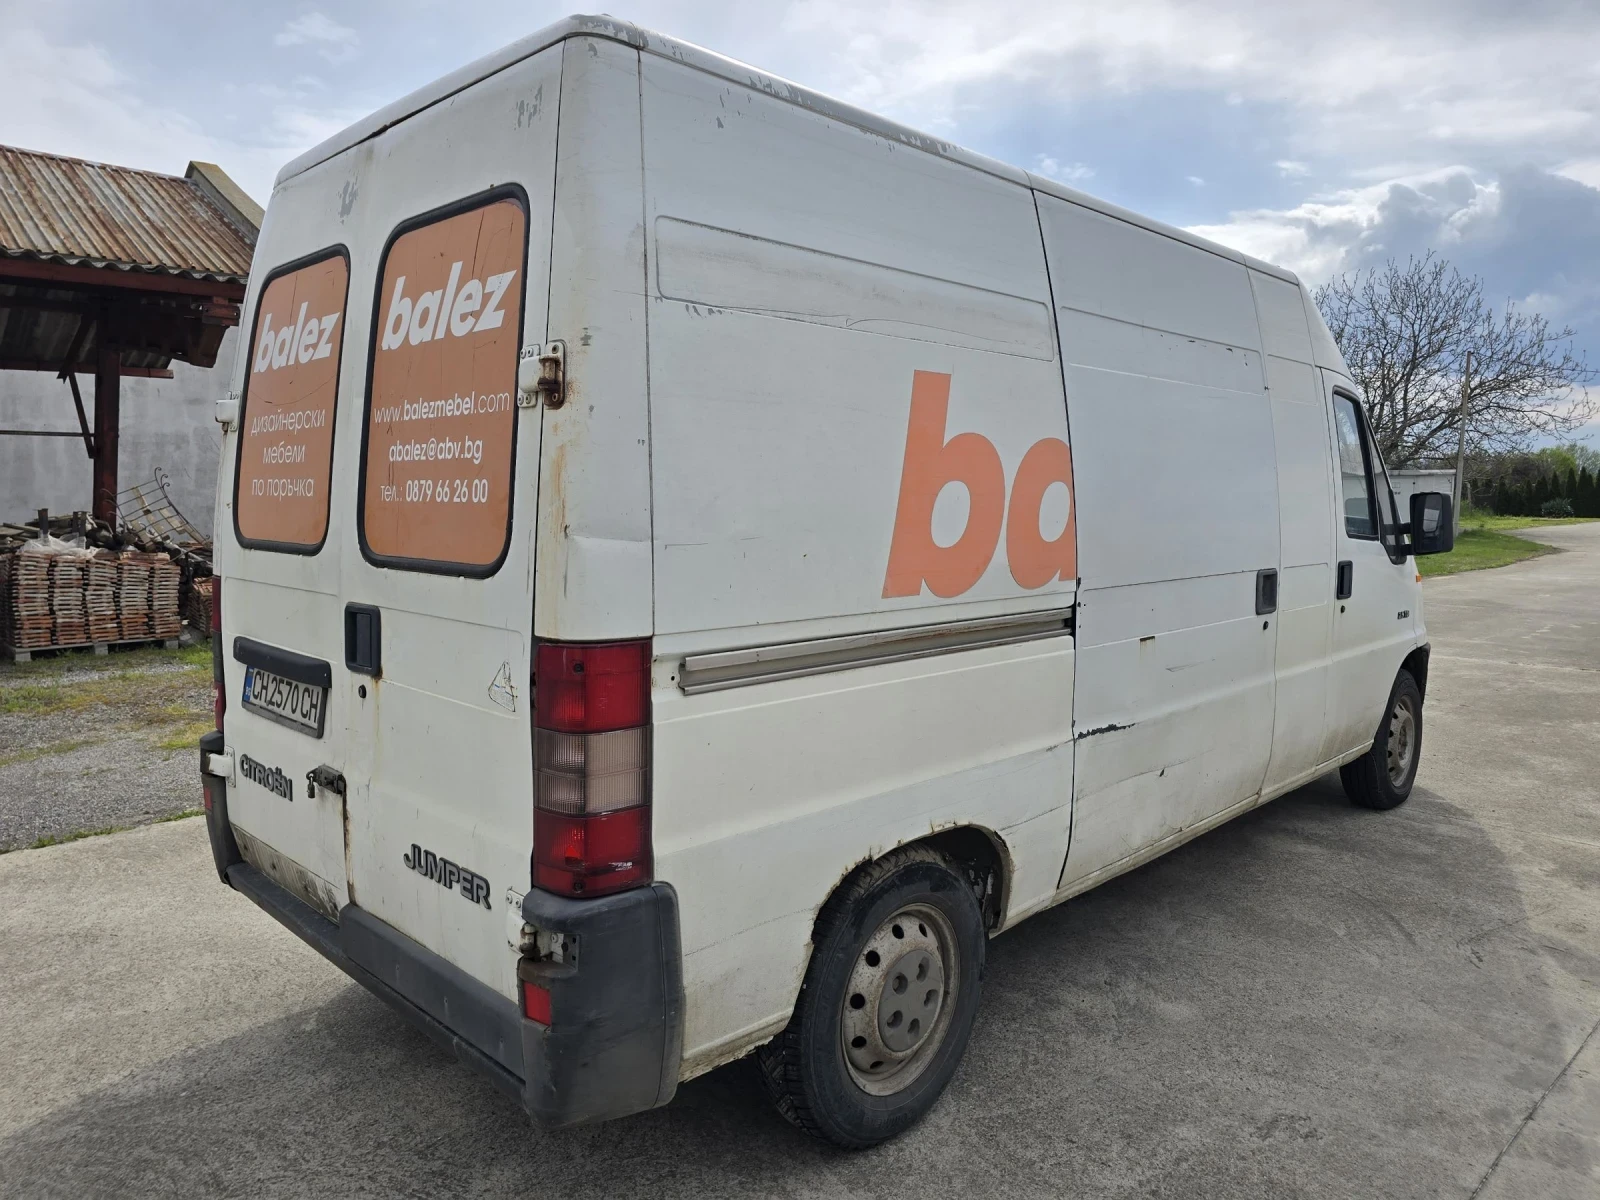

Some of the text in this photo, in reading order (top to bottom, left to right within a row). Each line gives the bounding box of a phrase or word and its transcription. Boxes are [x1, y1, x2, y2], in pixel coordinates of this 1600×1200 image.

[381, 260, 518, 351] balez
[253, 301, 341, 373] balez
[251, 407, 325, 437] дизайнерски
[374, 391, 510, 423] www.balezmebel.com
[263, 441, 305, 464] мебели
[389, 435, 483, 465] abalez@abv.bg
[251, 477, 314, 502] по поръчка
[405, 479, 433, 503] 0879
[435, 479, 450, 503] 66
[453, 479, 469, 503] 26
[472, 478, 489, 503] 00
[239, 753, 293, 803] CITROËN
[403, 843, 492, 910] JUMPER
